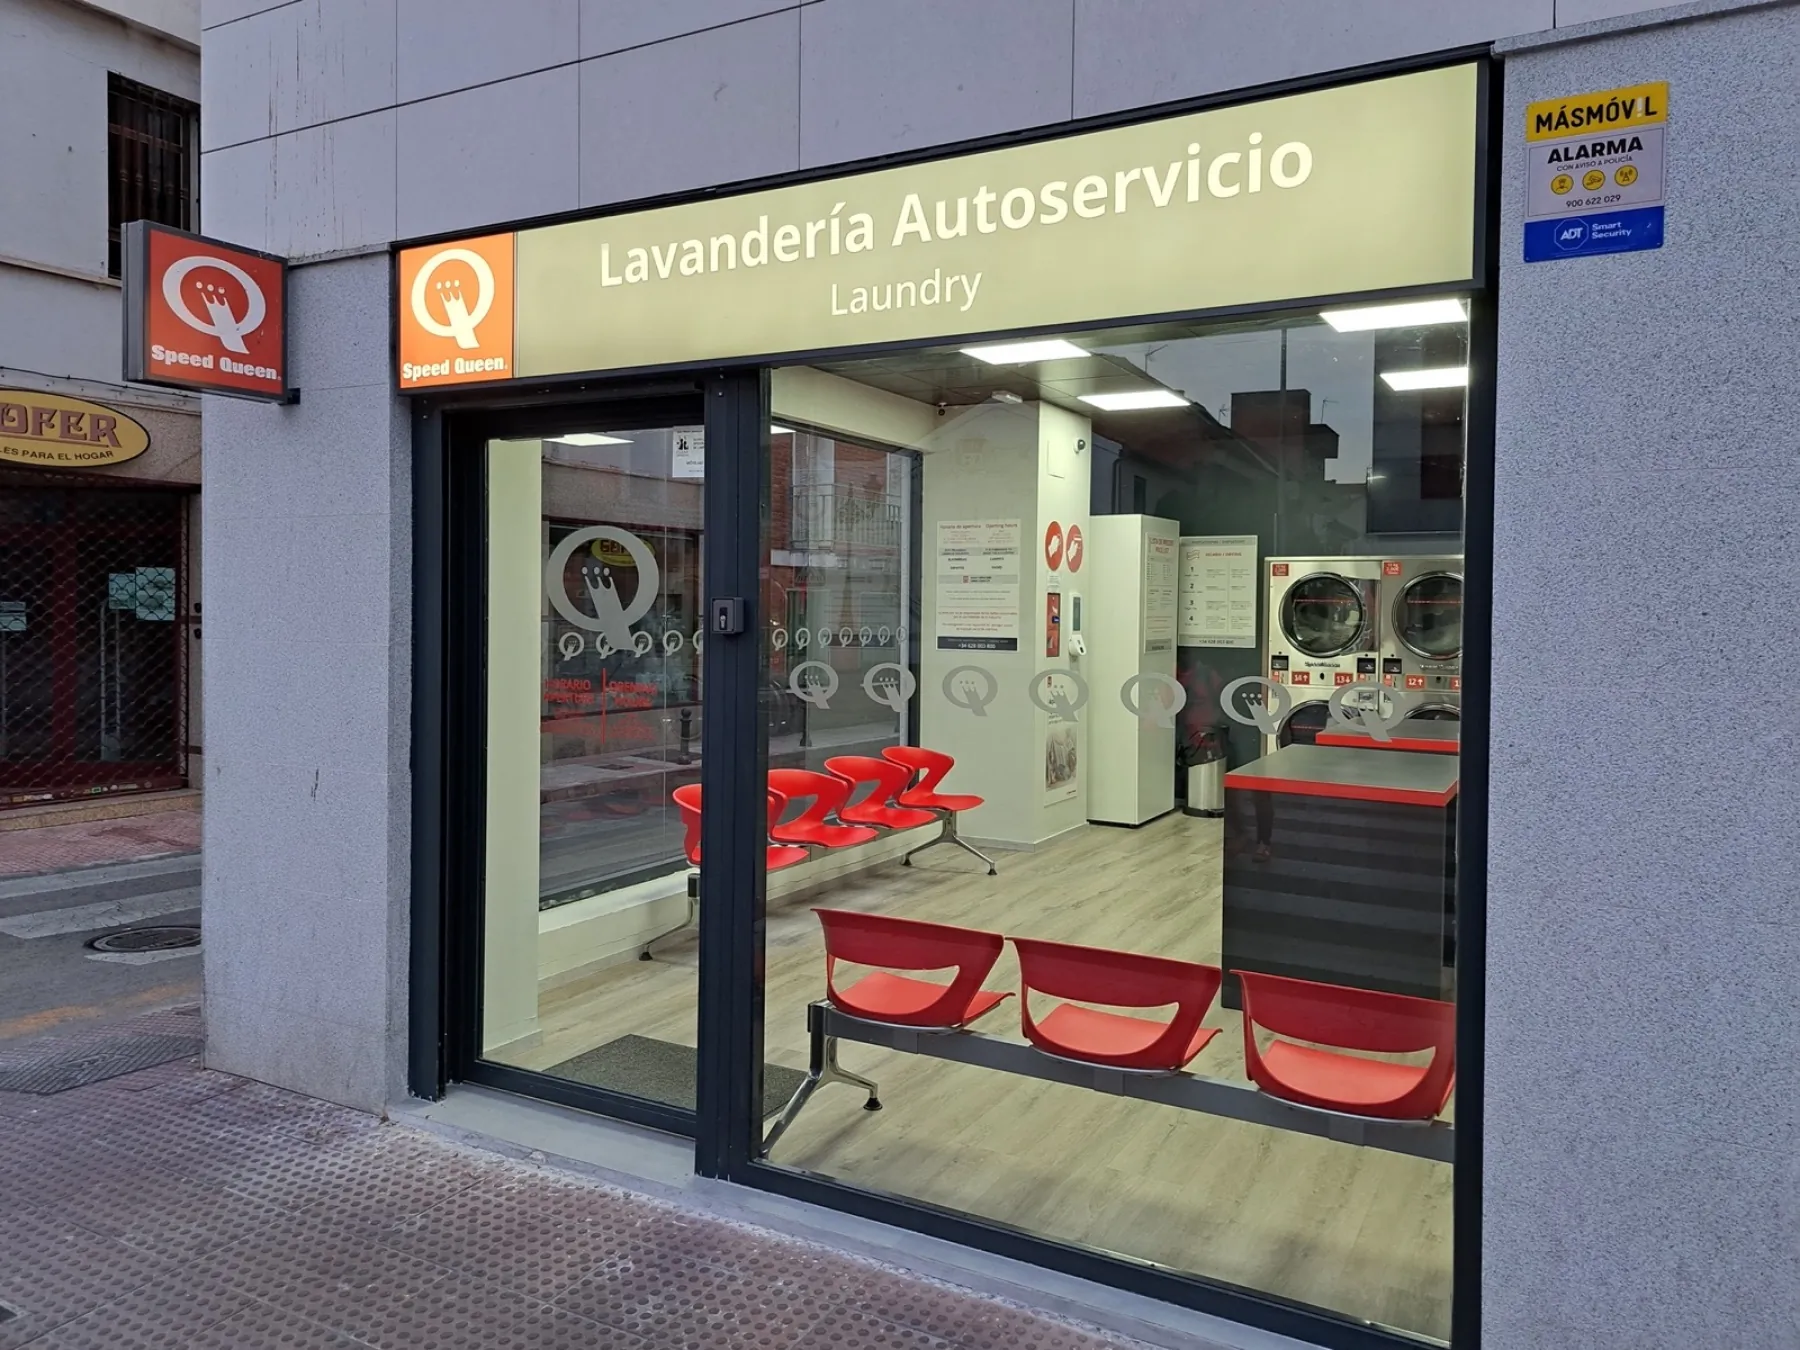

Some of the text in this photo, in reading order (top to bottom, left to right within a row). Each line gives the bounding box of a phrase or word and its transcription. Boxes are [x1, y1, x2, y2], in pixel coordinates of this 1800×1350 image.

[1547, 136, 1643, 164] ALARMA
[1556, 164, 1574, 172] CON
[1566, 194, 1621, 208] 900 622 029
[600, 131, 1314, 287] Lavandería Autoservicio
[1592, 221, 1622, 231] Smart
[1560, 227, 1583, 241] ADT
[1591, 229, 1632, 240] Security
[831, 269, 983, 316] Laundry
[151, 345, 278, 380] Speed Queen
[402, 357, 505, 381] Speed Queen
[0, 446, 19, 455] ES
[22, 449, 54, 460] PARA
[75, 450, 114, 460] HOGAR
